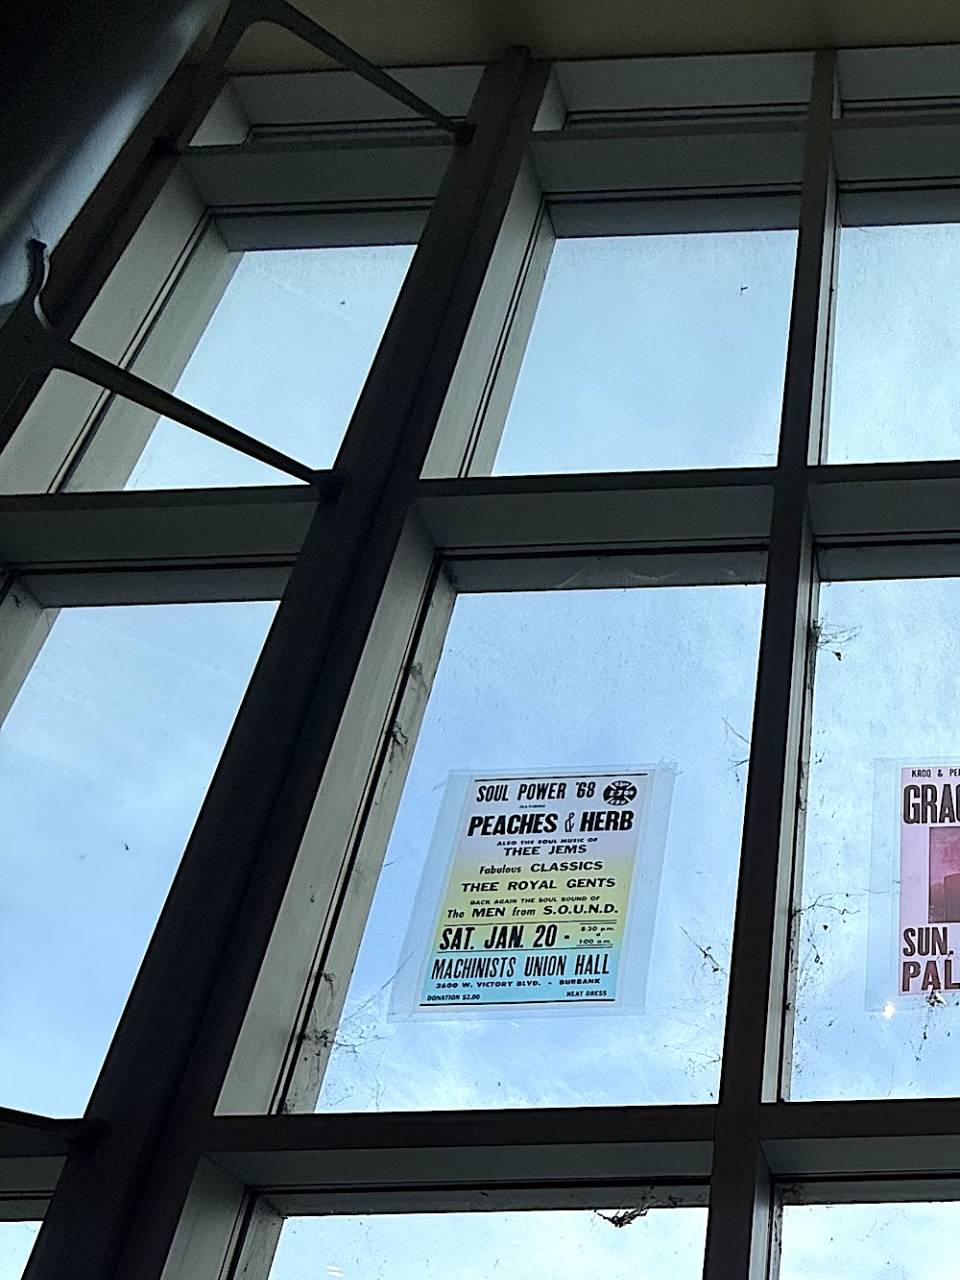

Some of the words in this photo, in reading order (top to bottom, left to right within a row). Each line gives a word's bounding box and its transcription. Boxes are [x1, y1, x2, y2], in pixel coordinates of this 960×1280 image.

[476, 784, 509, 802] SOUL
[517, 782, 567, 801] POWER
[576, 781, 596, 799] '68
[467, 813, 559, 836] PEACHES
[564, 812, 575, 833] &
[580, 810, 634, 832] HERB
[504, 845, 541, 857] THEE
[548, 844, 588, 855] JEMS
[479, 865, 522, 875] Fabulous
[530, 861, 604, 873] CLASSICS
[461, 881, 500, 893] THEE
[507, 880, 558, 891] ROYAL
[566, 878, 616, 889] GENTS
[447, 909, 465, 919] The
[472, 907, 506, 918] MEN
[512, 906, 536, 917] from
[543, 903, 619, 916] S.O.U.N.D.
[439, 926, 475, 951] SAT.
[483, 925, 524, 949] JAN.
[532, 924, 558, 948] 20
[903, 926, 954, 957] SUN.
[431, 956, 516, 980] MACHINISTS
[524, 955, 567, 977] UNION
[575, 953, 610, 975] HALL
[559, 978, 601, 986] BURBANK
[427, 994, 460, 1002] DONATION
